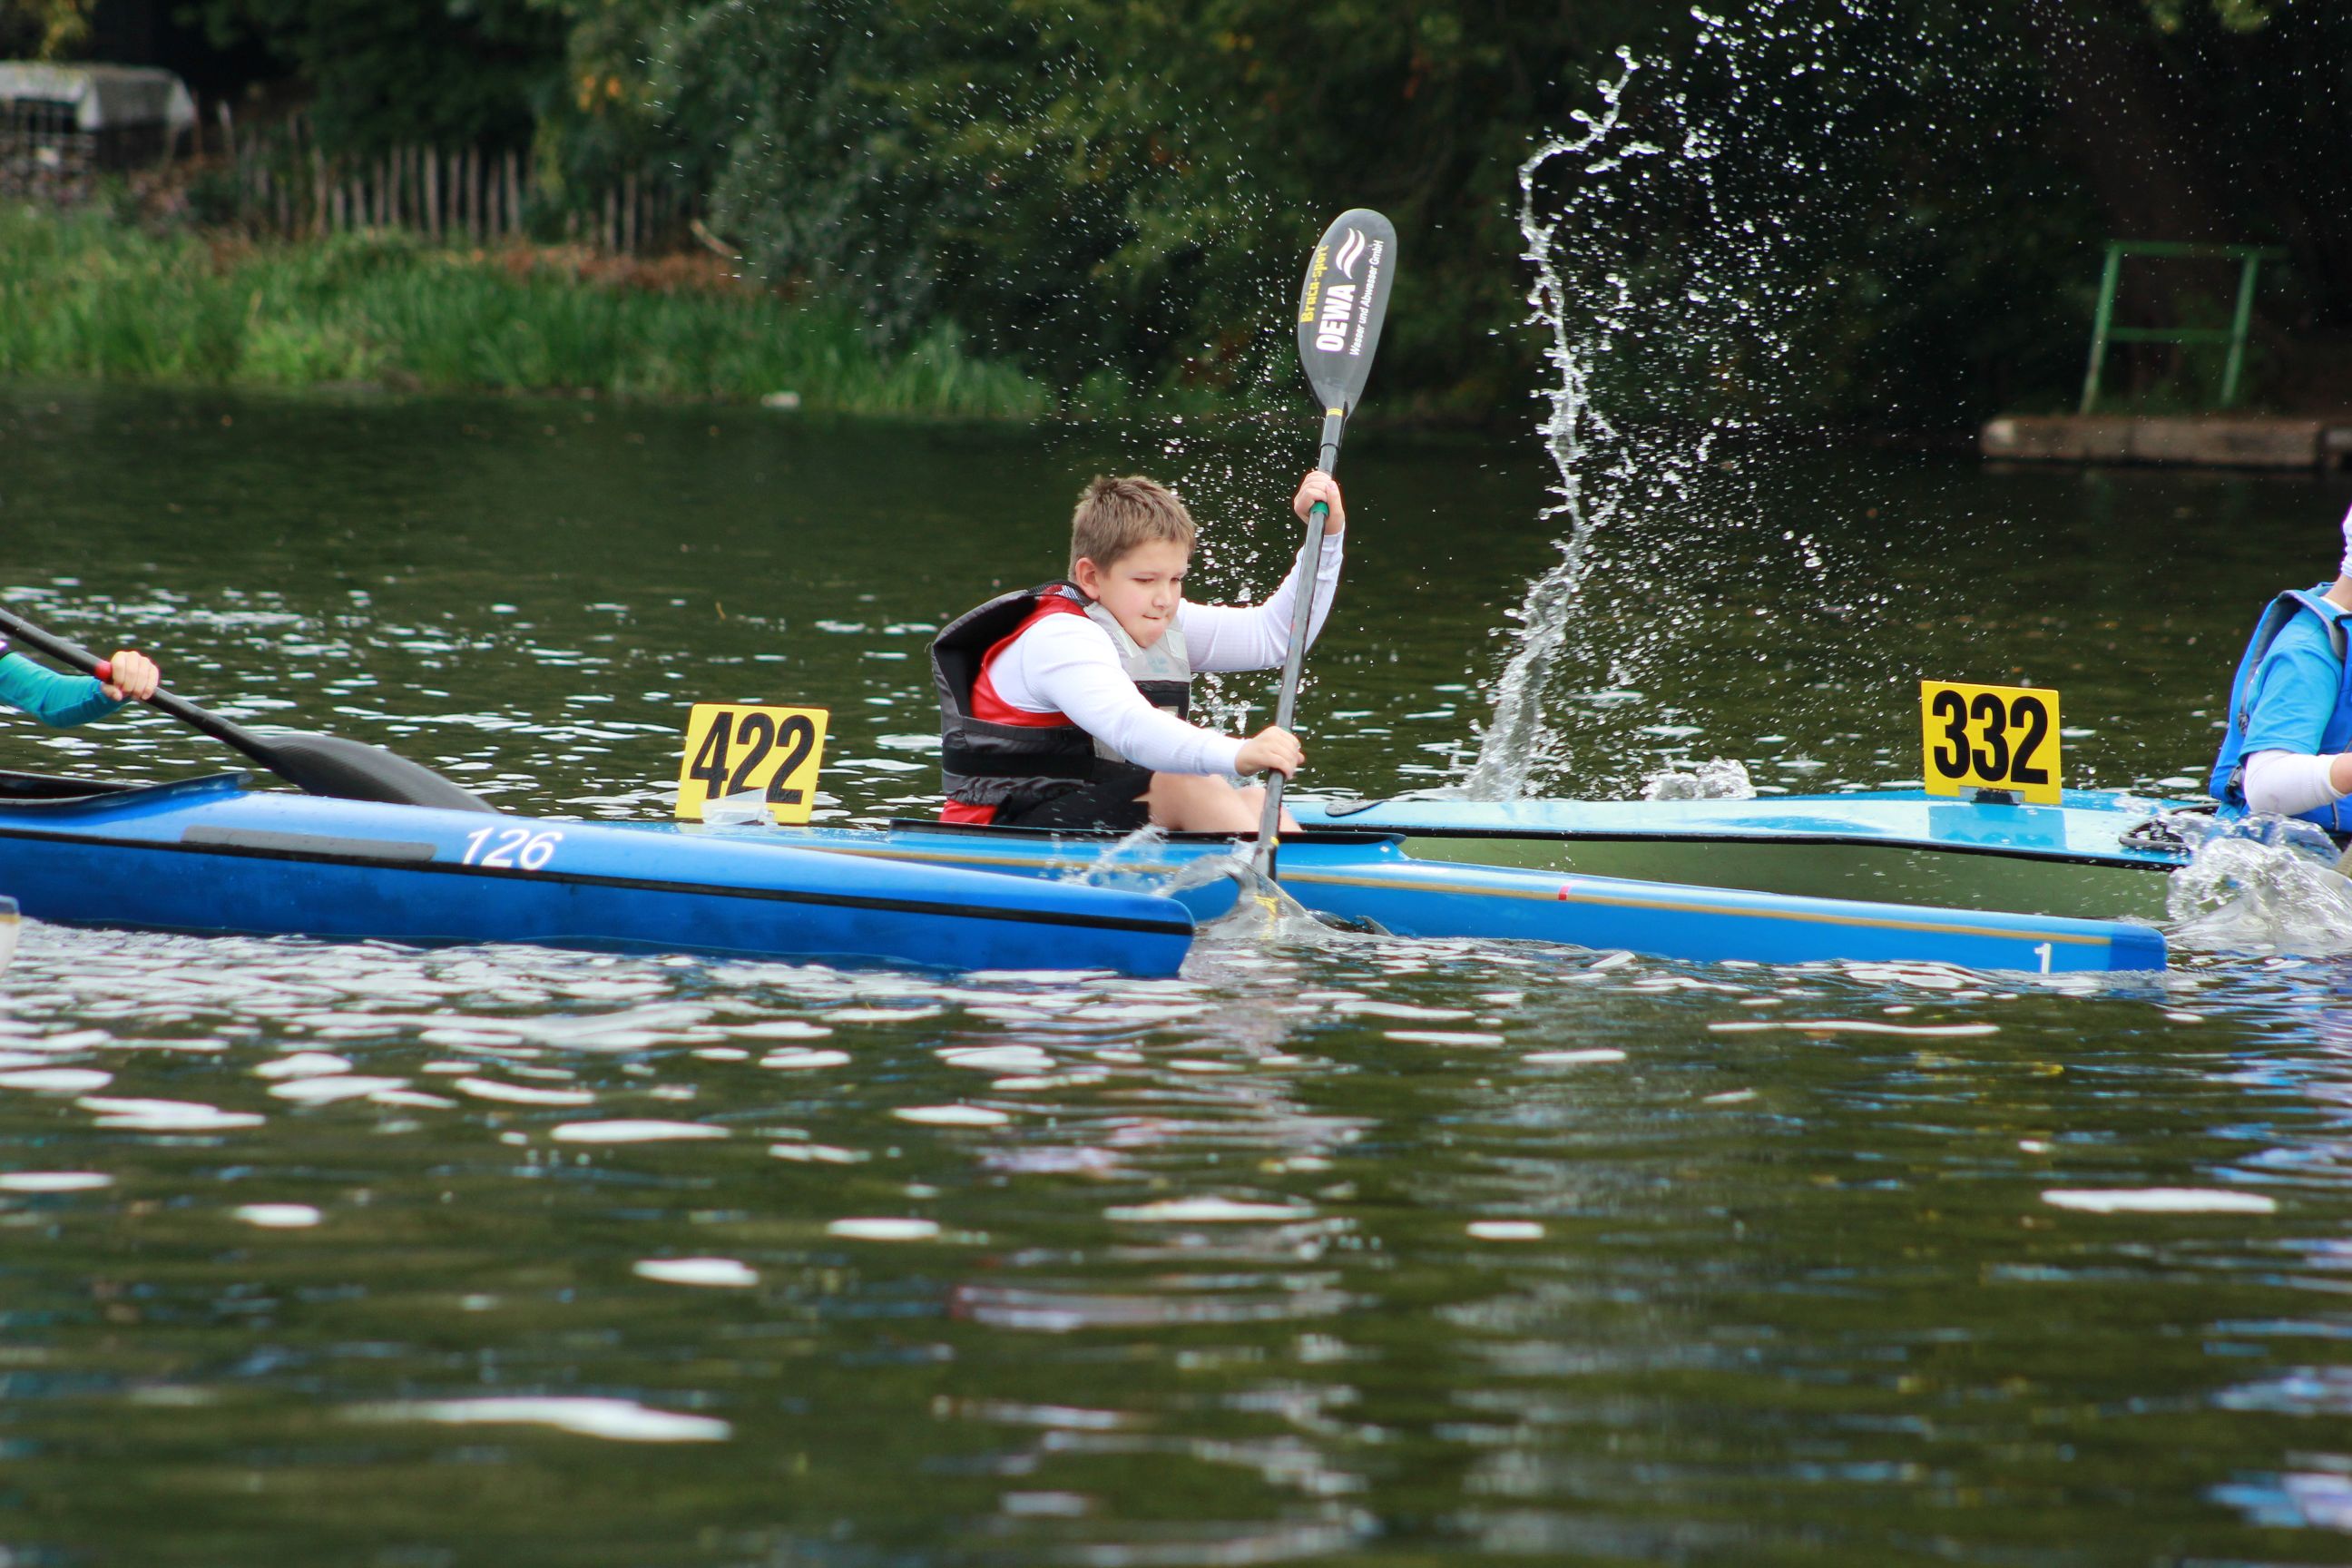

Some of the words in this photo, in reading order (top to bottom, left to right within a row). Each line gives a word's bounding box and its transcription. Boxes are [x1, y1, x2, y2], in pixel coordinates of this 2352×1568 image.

[1368, 240, 1385, 265] GmbH
[1360, 265, 1377, 308] Abwasser
[1316, 284, 1357, 352] OEWA
[1358, 306, 1369, 324] und
[1349, 324, 1365, 356] Wasser
[689, 711, 815, 805] 422
[1932, 690, 2049, 785] 332
[462, 827, 564, 871] 126
[2034, 943, 2052, 975] 1
